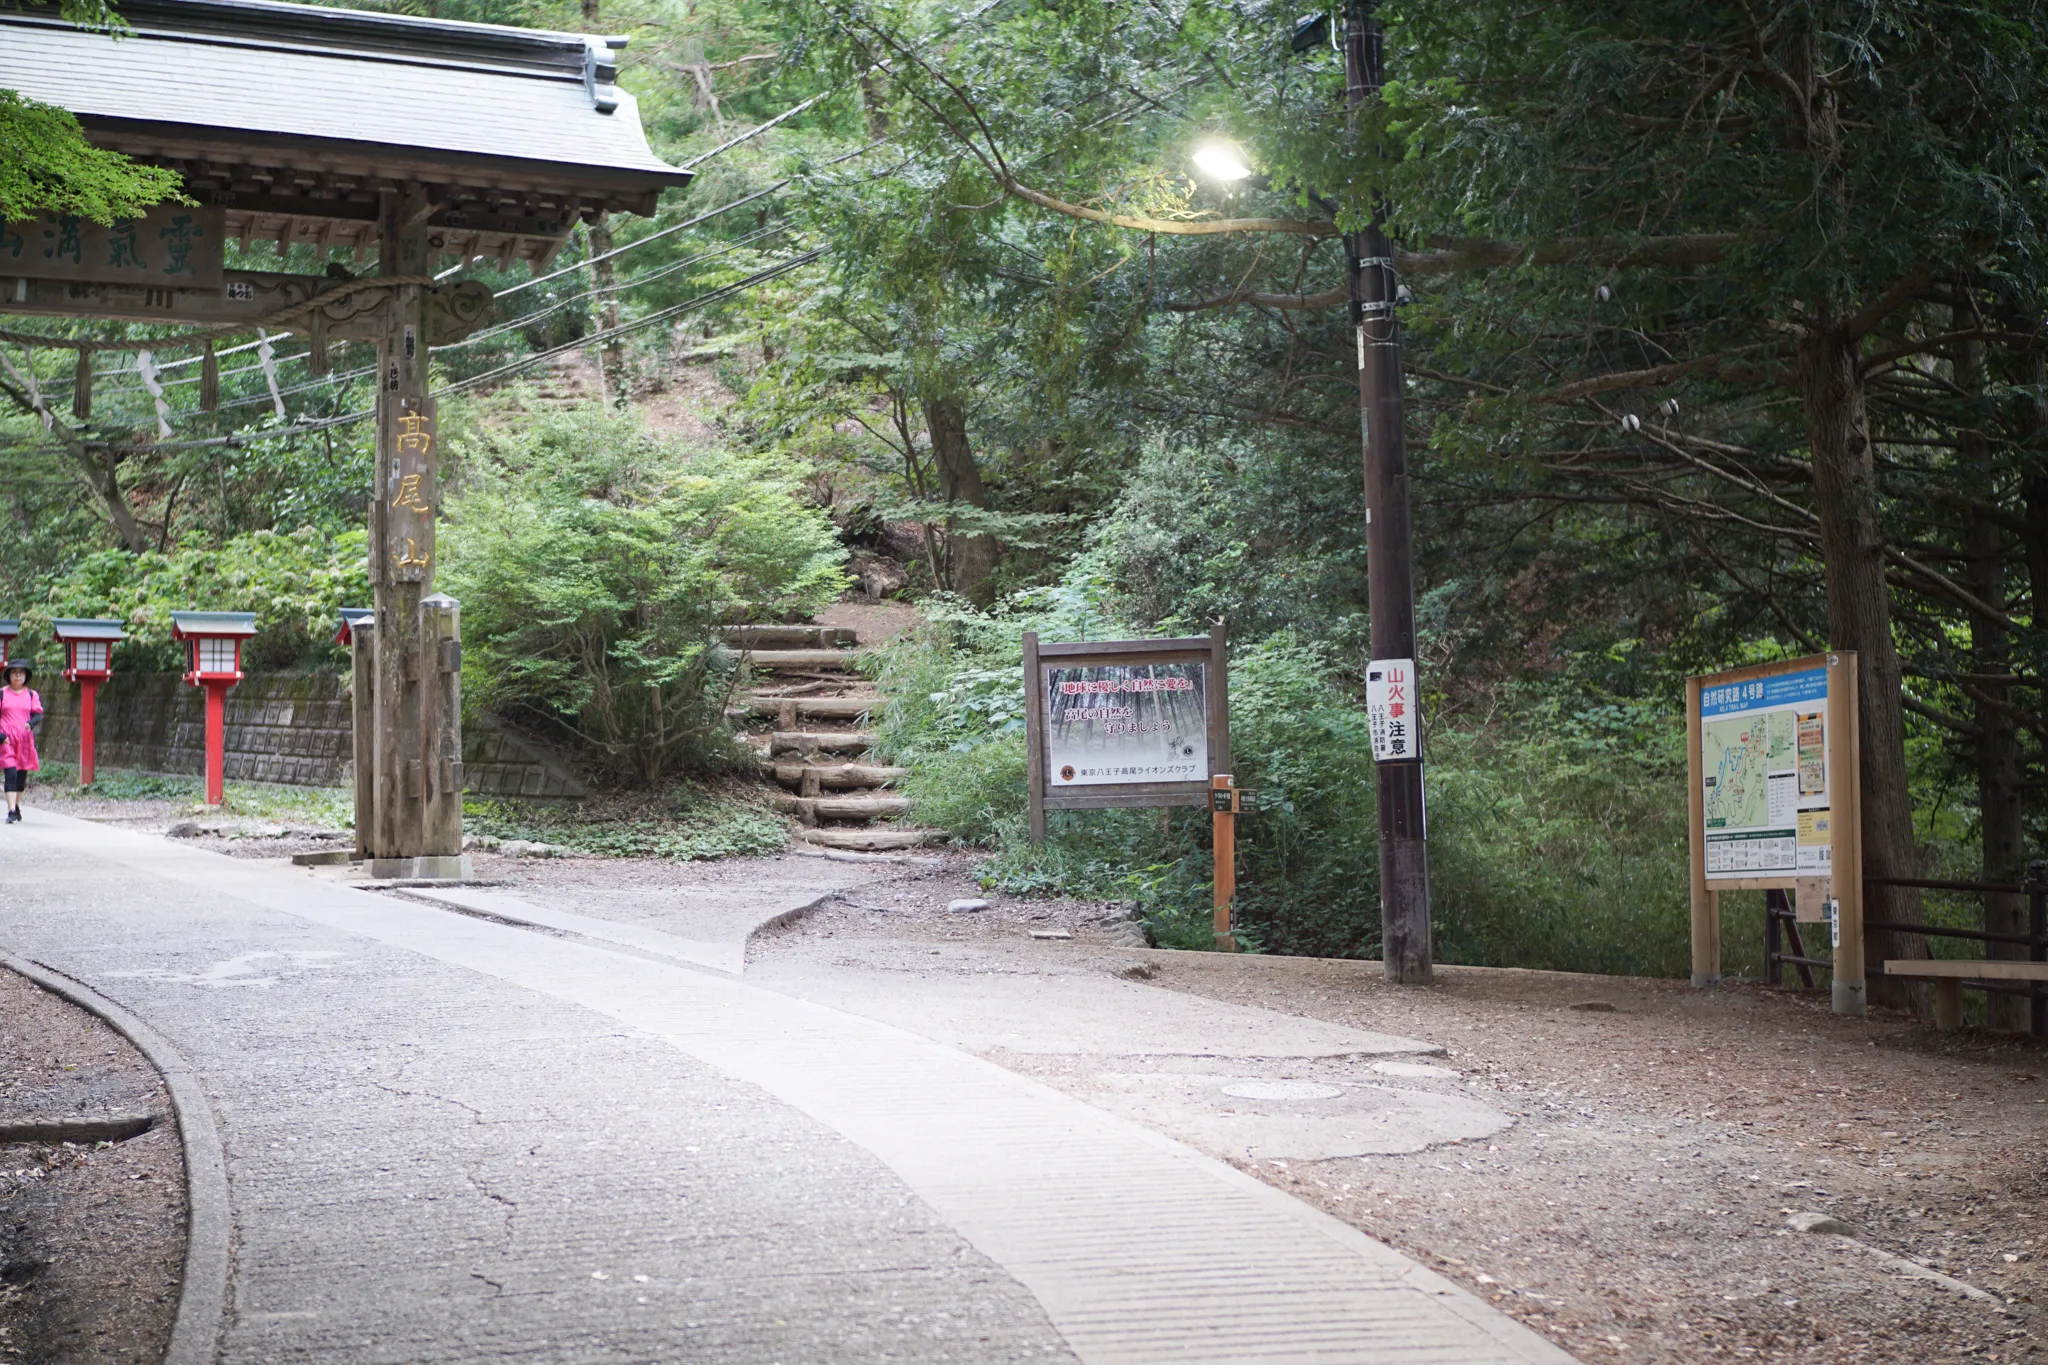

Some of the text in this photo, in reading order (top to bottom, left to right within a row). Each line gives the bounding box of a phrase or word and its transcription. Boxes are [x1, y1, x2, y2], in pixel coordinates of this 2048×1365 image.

[1703, 687, 1740, 707] 自然研究路
[1742, 682, 1764, 700] 4号路
[1064, 707, 1133, 721] 高尾の自然を
[1387, 667, 1406, 755] 山火事注意
[1103, 720, 1172, 734] 守りましょう
[1378, 704, 1386, 751] 八王子消防署
[1080, 765, 1196, 776] 東京八王子高尾ライオンズクラブ
